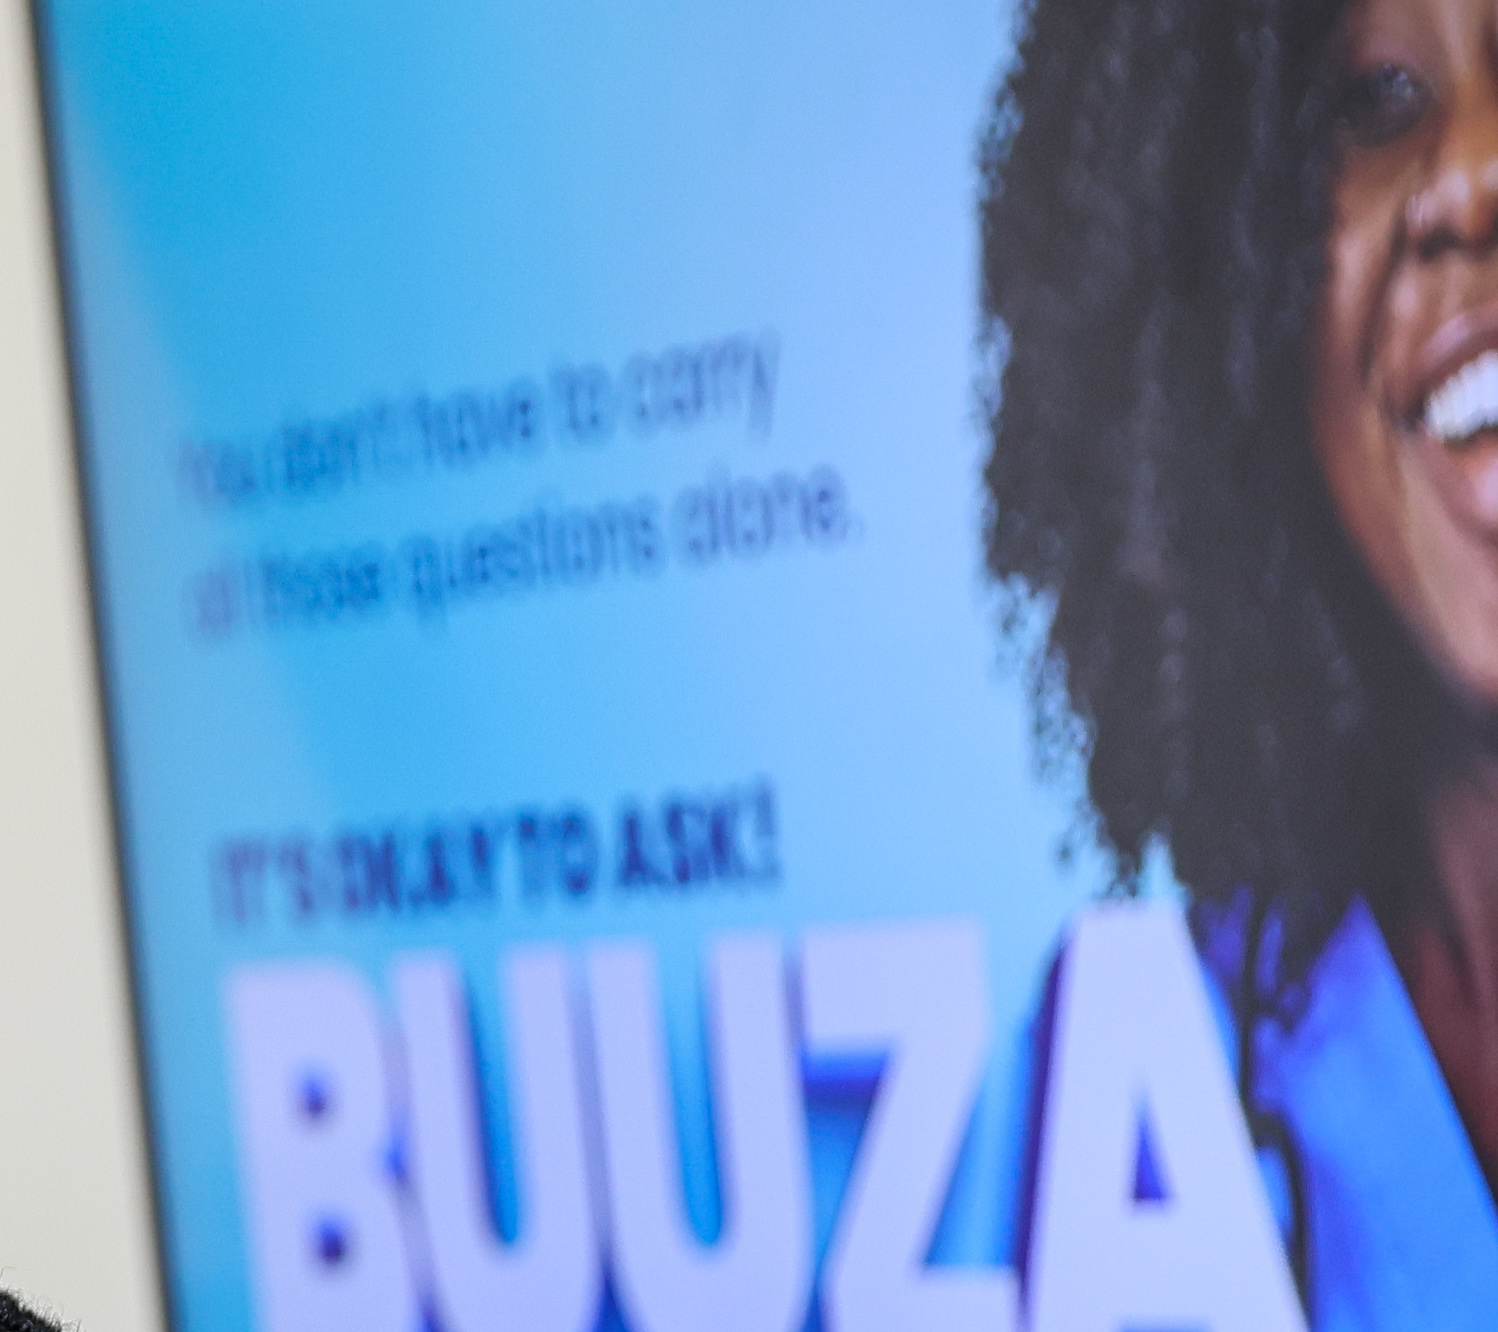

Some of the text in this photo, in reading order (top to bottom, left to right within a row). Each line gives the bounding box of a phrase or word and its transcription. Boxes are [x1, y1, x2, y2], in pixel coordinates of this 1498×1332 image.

[414, 378, 540, 466] have
[550, 357, 614, 438] to
[624, 328, 780, 444] carry
[399, 488, 662, 638] questions
[668, 464, 864, 569] alone.
[614, 778, 782, 890] ASK!
